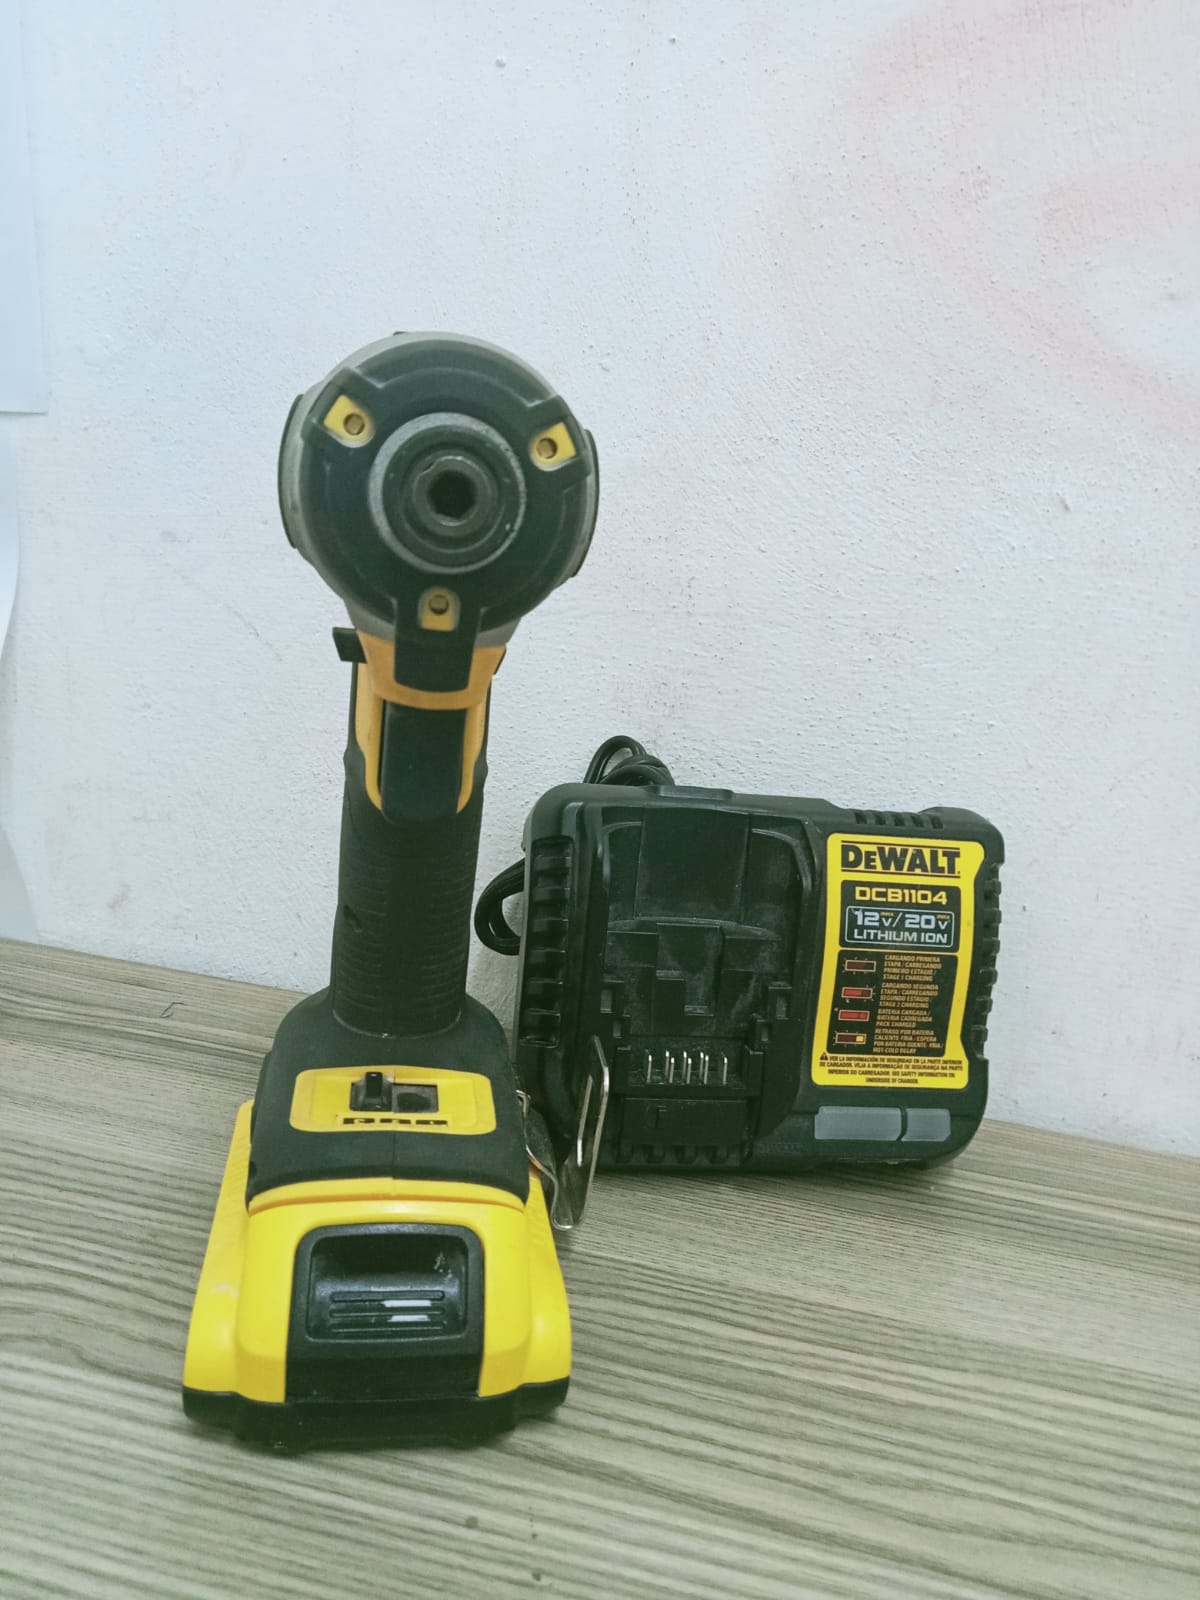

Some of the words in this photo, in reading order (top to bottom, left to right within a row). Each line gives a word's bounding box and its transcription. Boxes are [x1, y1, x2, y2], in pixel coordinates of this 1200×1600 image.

[841, 844, 960, 874] DEWALT
[855, 886, 947, 905] DCB1104
[854, 928, 917, 942] LITHIUM
[921, 932, 947, 944] ION
